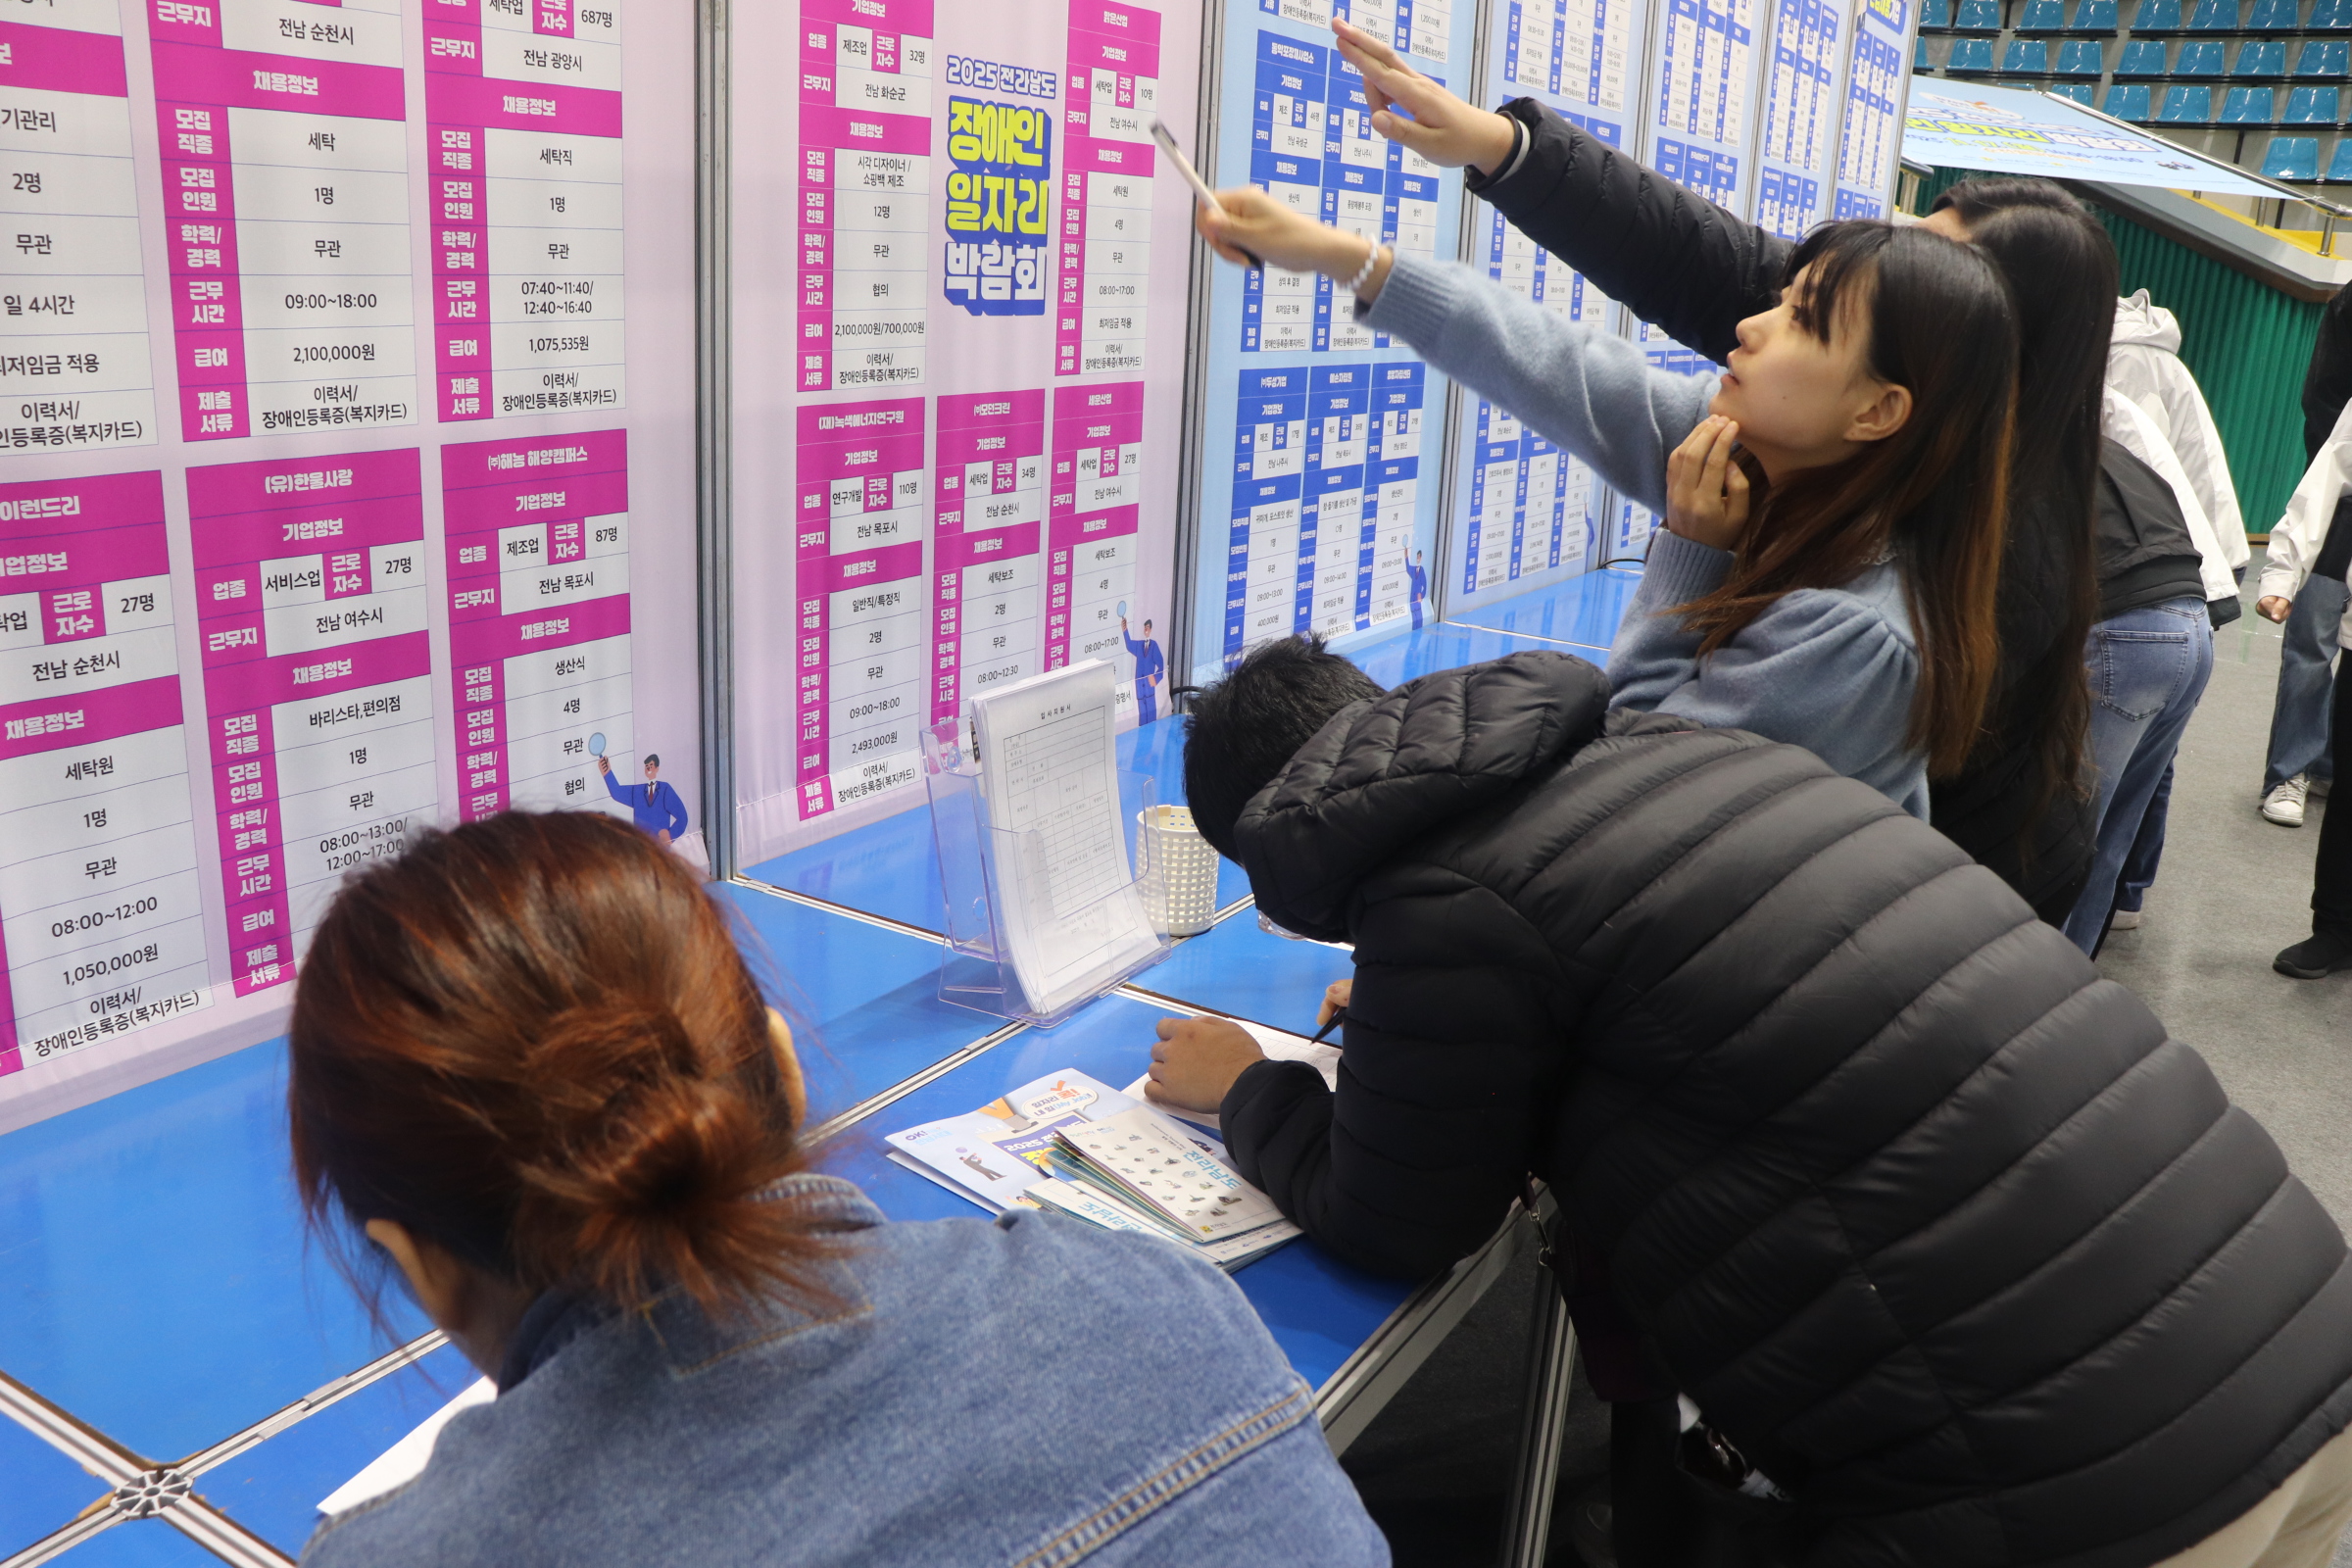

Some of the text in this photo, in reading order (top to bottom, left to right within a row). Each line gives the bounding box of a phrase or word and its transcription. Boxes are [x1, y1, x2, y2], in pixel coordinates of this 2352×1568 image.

[157, 1, 211, 26] 근무지
[542, 12, 566, 30] 자수
[582, 10, 612, 27] 687명
[279, 19, 353, 45] 전남 순천시
[431, 37, 474, 59] 근무지
[844, 40, 866, 55] 제조업
[909, 50, 924, 64] 32명
[1102, 46, 1126, 61] 기업정보
[524, 50, 581, 72] 전남 광양시
[254, 71, 318, 95] 채용정보
[804, 74, 830, 91] 근무지
[947, 55, 1056, 98] 2025 전라남도
[866, 84, 906, 101] 전남 화순군
[503, 96, 556, 116] 채용정보
[175, 110, 211, 130] 모집
[851, 122, 883, 138] 채용정보
[950, 100, 1044, 167] 장애인
[178, 133, 213, 154] 직종
[309, 132, 335, 151] 세탁
[540, 149, 571, 166] 세탁직
[858, 157, 905, 172] 시각 디자이너
[13, 173, 40, 193] 2명
[864, 173, 904, 187] 쇼핑백 제조
[182, 192, 217, 211] 인원
[316, 187, 333, 204] 1명
[946, 173, 1049, 235] 일자리
[875, 206, 889, 219] 12명
[181, 224, 221, 244] 학력/
[17, 235, 51, 254] 무관
[315, 240, 341, 257] 무관
[874, 245, 889, 257] 무관
[187, 249, 220, 267] 경력
[946, 242, 1048, 301] 박람회
[189, 282, 222, 300] 근무
[522, 281, 593, 295] 07:40~11:40/
[873, 284, 888, 296] 협의
[29, 295, 74, 315] 4시간
[286, 294, 376, 309] 09:00~18:00
[524, 301, 591, 314] 12:40~16:40
[192, 305, 224, 322] 시간
[294, 344, 374, 364] 2,100,000원
[530, 336, 588, 353] 1,075,535원
[68, 354, 99, 372] 적용
[194, 348, 227, 367] 급여
[867, 353, 893, 366] 이력서/
[544, 373, 578, 388] 이력서/
[198, 391, 231, 410] 제출
[315, 385, 358, 403] 이력서/
[503, 386, 615, 411] 장애인등록증(복지카드)
[22, 401, 79, 421] 이력서/
[263, 400, 407, 428] 장애인등록증(복지카드)
[201, 414, 232, 432] 서류
[527, 447, 587, 466] 해양캠퍼스
[845, 450, 877, 466] 기업정보
[266, 469, 353, 493] (유)한울사랑
[970, 473, 987, 485] 세탁업
[1022, 466, 1035, 477] 34명
[833, 490, 860, 505] 연구개발
[900, 482, 916, 494] 110명
[516, 492, 565, 512] 기업정보
[987, 504, 1017, 517] 전남 순천시
[283, 518, 343, 541] 기업정보
[555, 523, 578, 540] 근로
[596, 527, 616, 542] 87명
[858, 521, 897, 538] 전남 목포시
[508, 538, 538, 556] 제조업
[556, 539, 578, 559] 자수
[386, 557, 411, 573] 27명
[266, 569, 319, 592] 서비스업
[540, 572, 593, 594] 전남 목포시
[989, 569, 1013, 583] 세탁보조
[214, 580, 246, 600] 업종
[455, 588, 494, 609] 근무지
[53, 591, 91, 615] 근로
[122, 593, 154, 612] 27명
[853, 592, 900, 612] 일반직/특정직
[56, 614, 96, 639] 자수
[317, 608, 382, 633] 전남 여수시
[521, 618, 568, 640] 채용정보
[870, 631, 881, 643] 2명
[33, 651, 120, 681] 전남 순천시
[293, 659, 352, 684] 채용정보
[310, 696, 401, 729] 바리스타,편의점
[564, 698, 579, 712] 4명
[850, 698, 900, 718] 09:00~18:00
[5, 710, 84, 740] 채용정보
[564, 739, 583, 755] 무관
[853, 731, 897, 754] 2,493,000원
[66, 756, 113, 780] 세탁원
[863, 764, 890, 782] 이력서/
[565, 778, 584, 795] 협의
[84, 808, 106, 827] 1명
[85, 858, 117, 879] 무관
[52, 897, 157, 937] 08:00~12:00
[64, 944, 158, 985] 1,050,000원
[91, 987, 144, 1016] 이력서/
[1003, 1139, 1044, 1152] 2025
